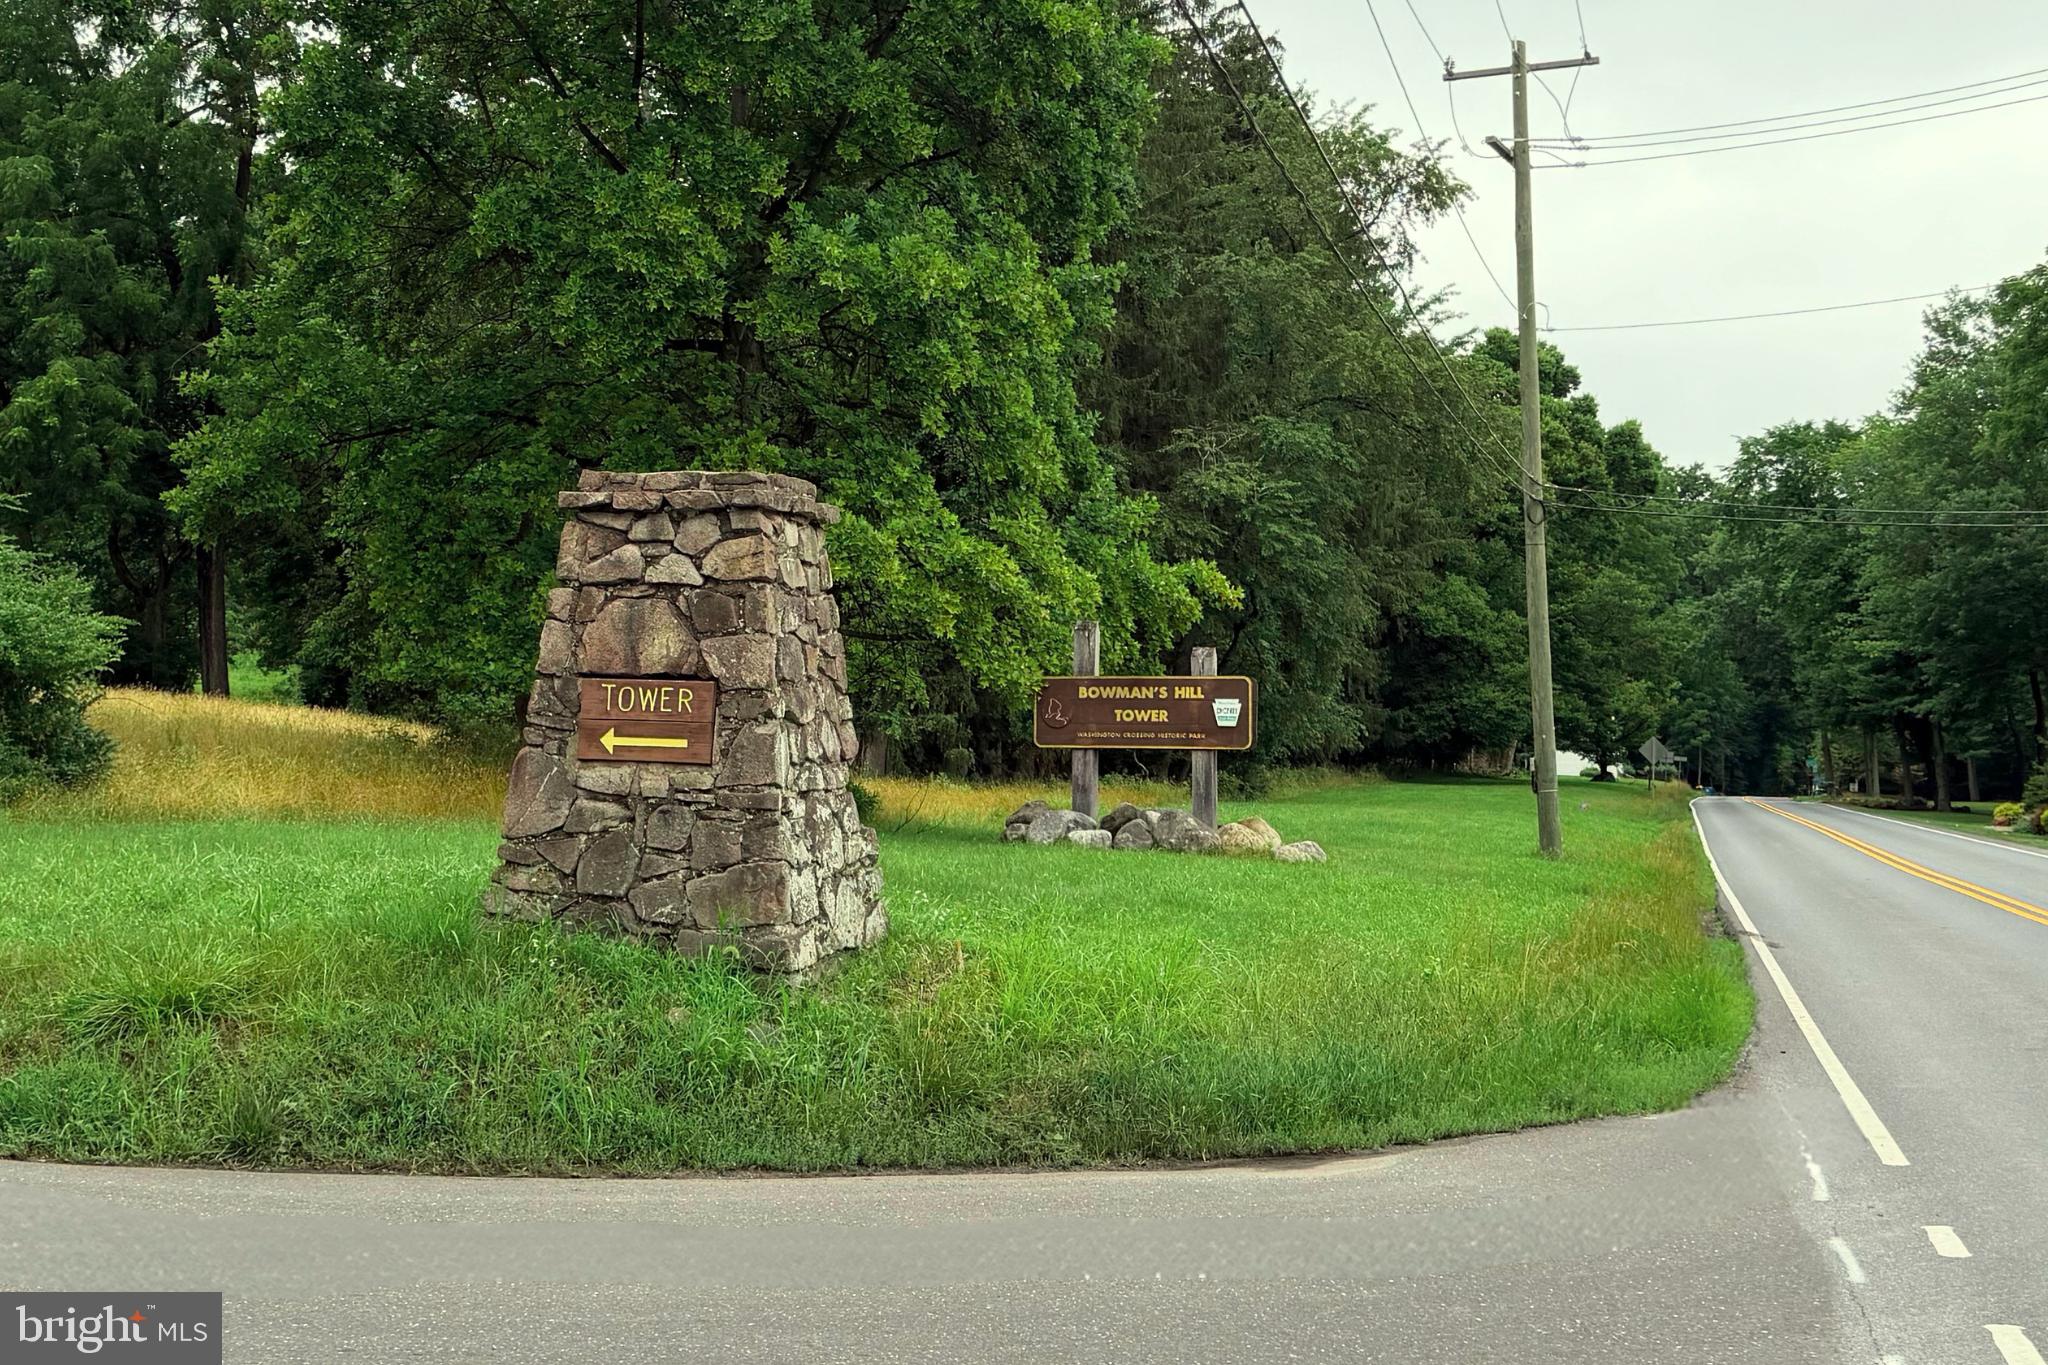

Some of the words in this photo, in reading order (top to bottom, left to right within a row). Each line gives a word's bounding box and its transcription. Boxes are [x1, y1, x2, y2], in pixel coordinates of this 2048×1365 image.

[601, 683, 693, 713] TOWER
[1078, 686, 1168, 699] BOWMAN'S
[1174, 686, 1205, 699] HILL
[1114, 709, 1169, 723] TOWER
